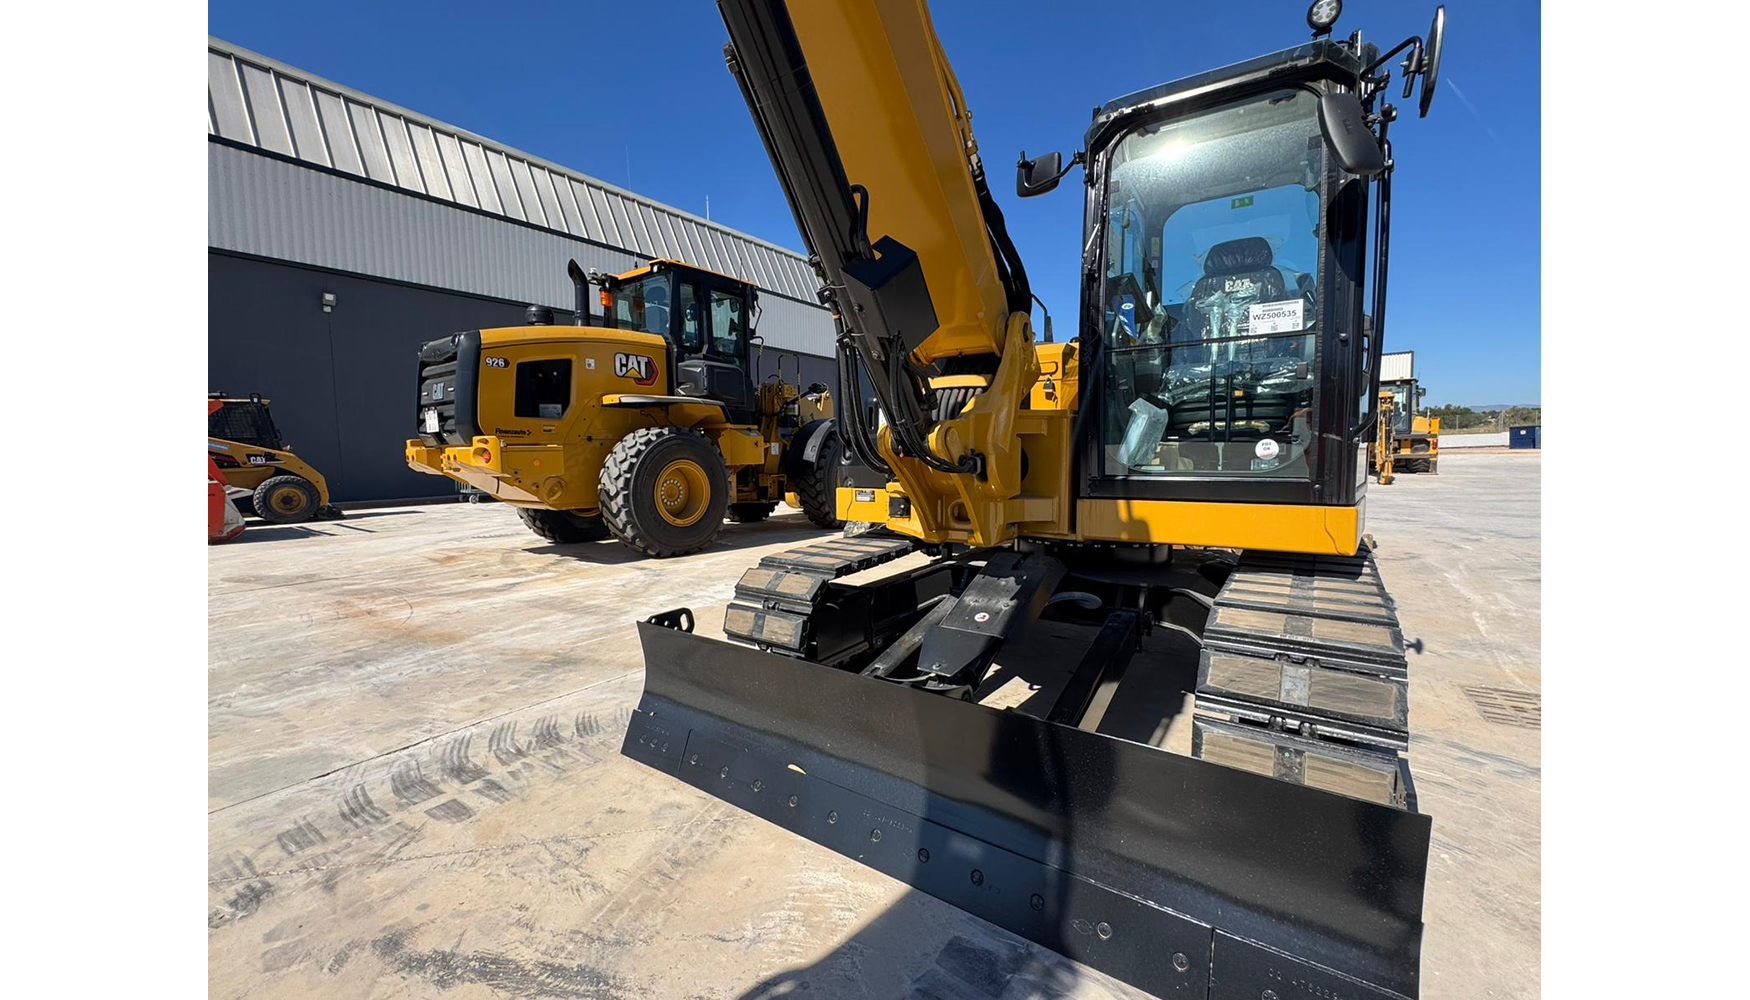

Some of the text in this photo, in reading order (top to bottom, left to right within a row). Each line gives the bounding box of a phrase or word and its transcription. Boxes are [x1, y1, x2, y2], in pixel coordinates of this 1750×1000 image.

[1253, 309, 1297, 321] WZ500535
[486, 357, 505, 367] 926
[615, 353, 648, 379] CAT
[433, 382, 445, 400] CAT
[495, 427, 526, 435] Finanzauto
